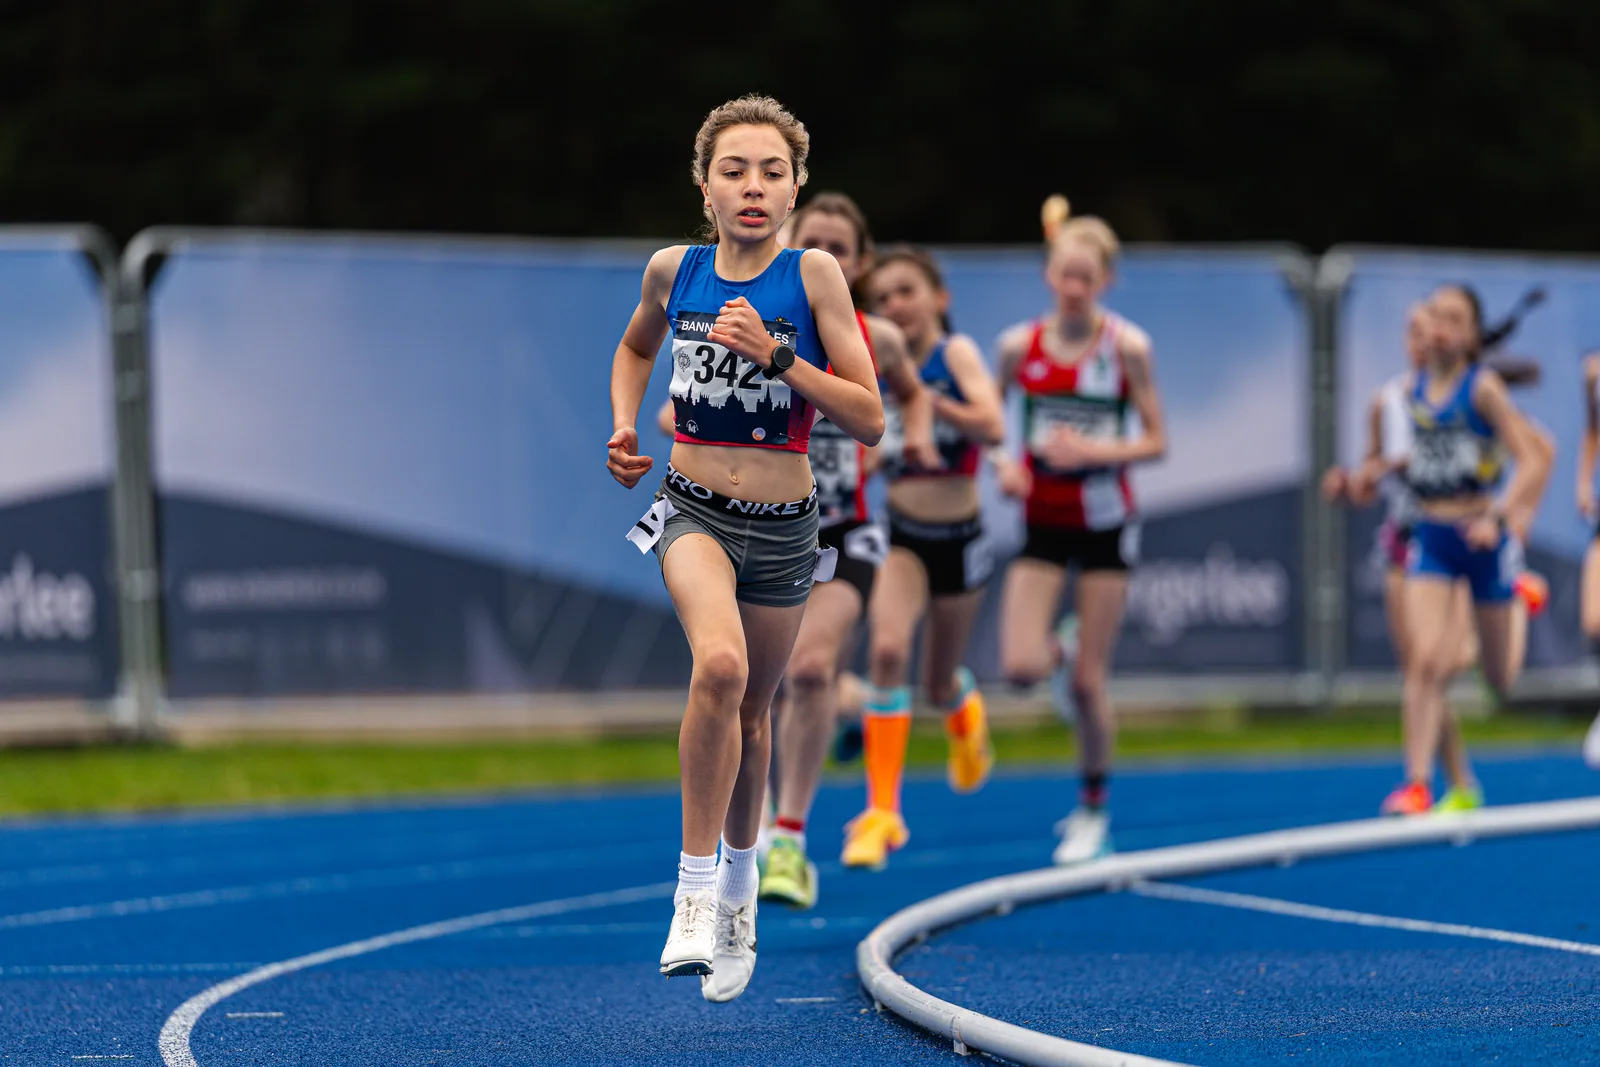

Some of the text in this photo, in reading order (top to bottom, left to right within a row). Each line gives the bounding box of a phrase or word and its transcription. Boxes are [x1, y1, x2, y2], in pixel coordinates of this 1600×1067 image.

[681, 320, 714, 333] BANN
[694, 345, 762, 391] 342
[725, 498, 803, 516] NIKE
